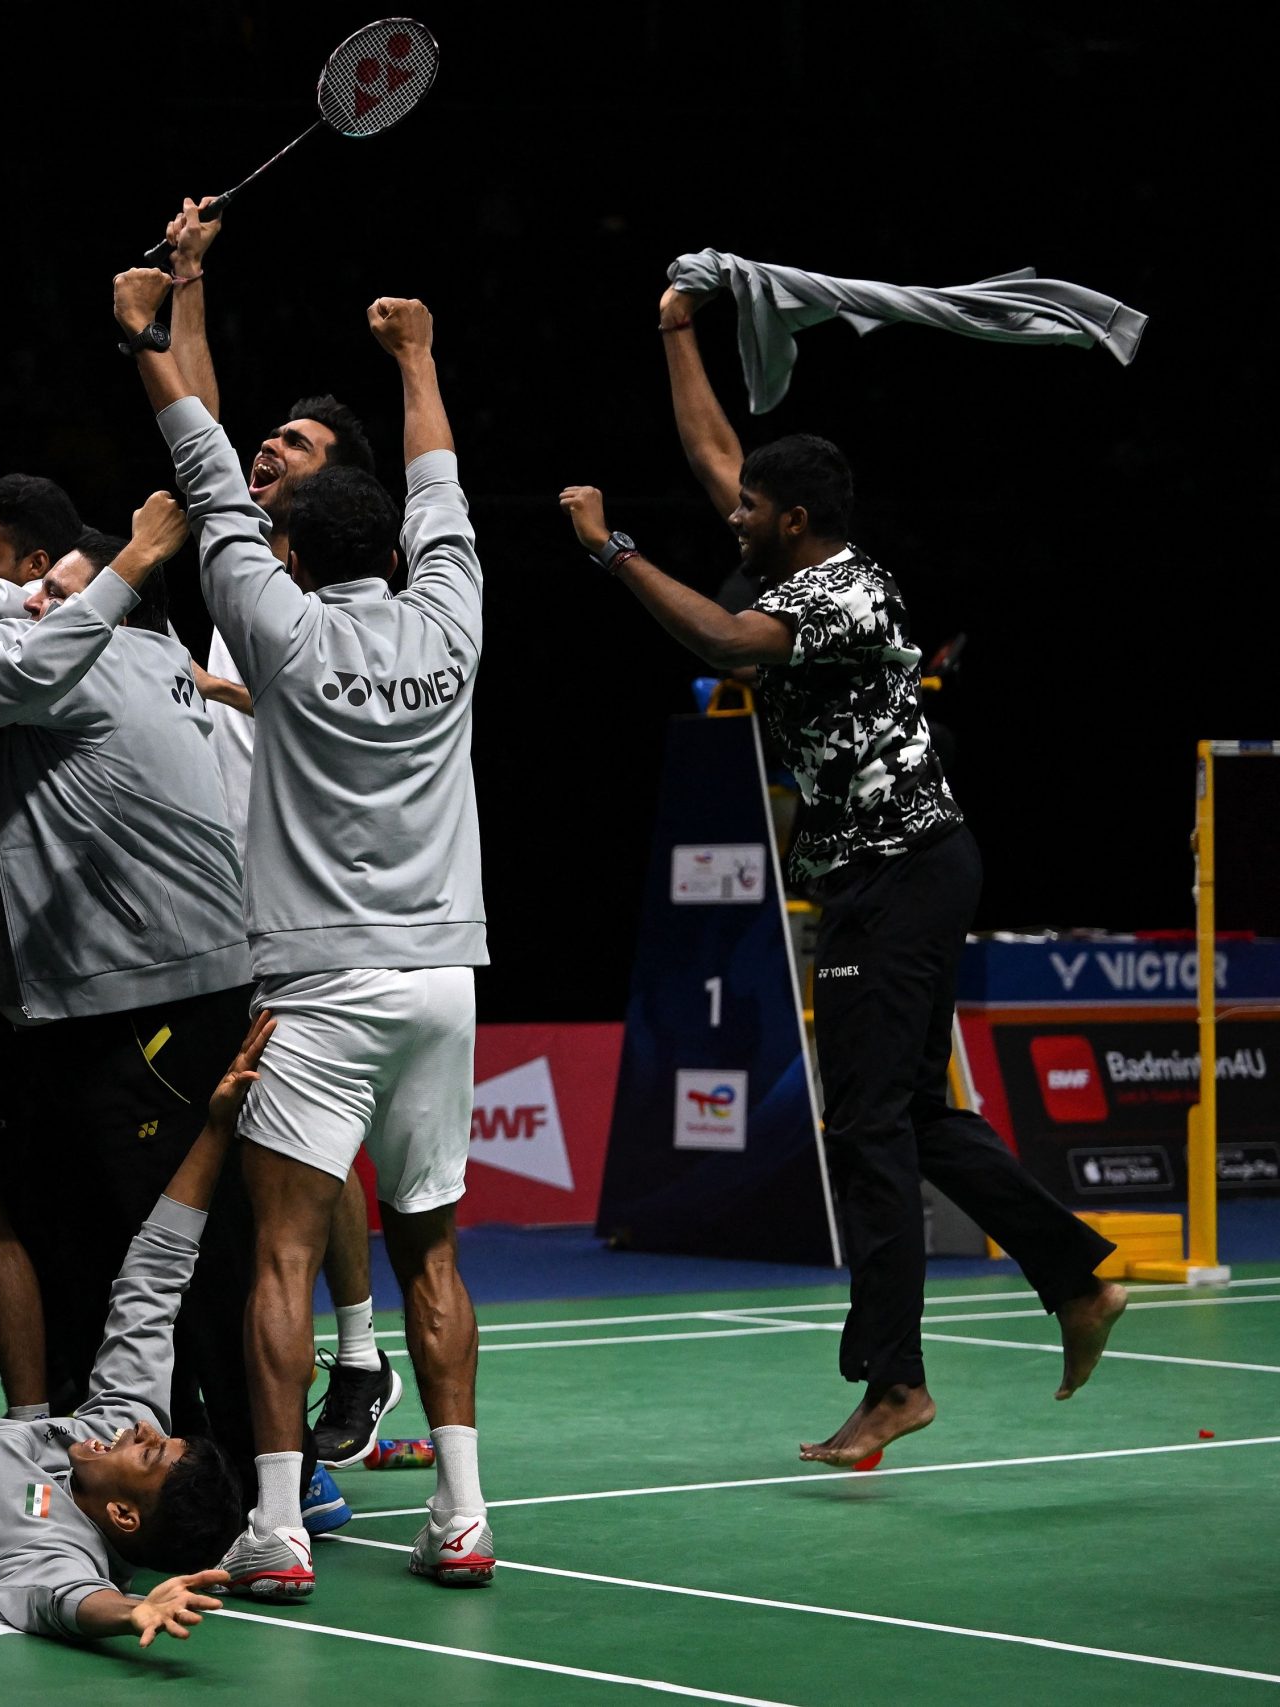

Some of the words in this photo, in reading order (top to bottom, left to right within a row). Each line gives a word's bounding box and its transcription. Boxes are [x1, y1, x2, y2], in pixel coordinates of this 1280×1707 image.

[376, 665, 465, 713] YONEX
[830, 965, 860, 979] YONEX
[704, 976, 723, 1029] 1
